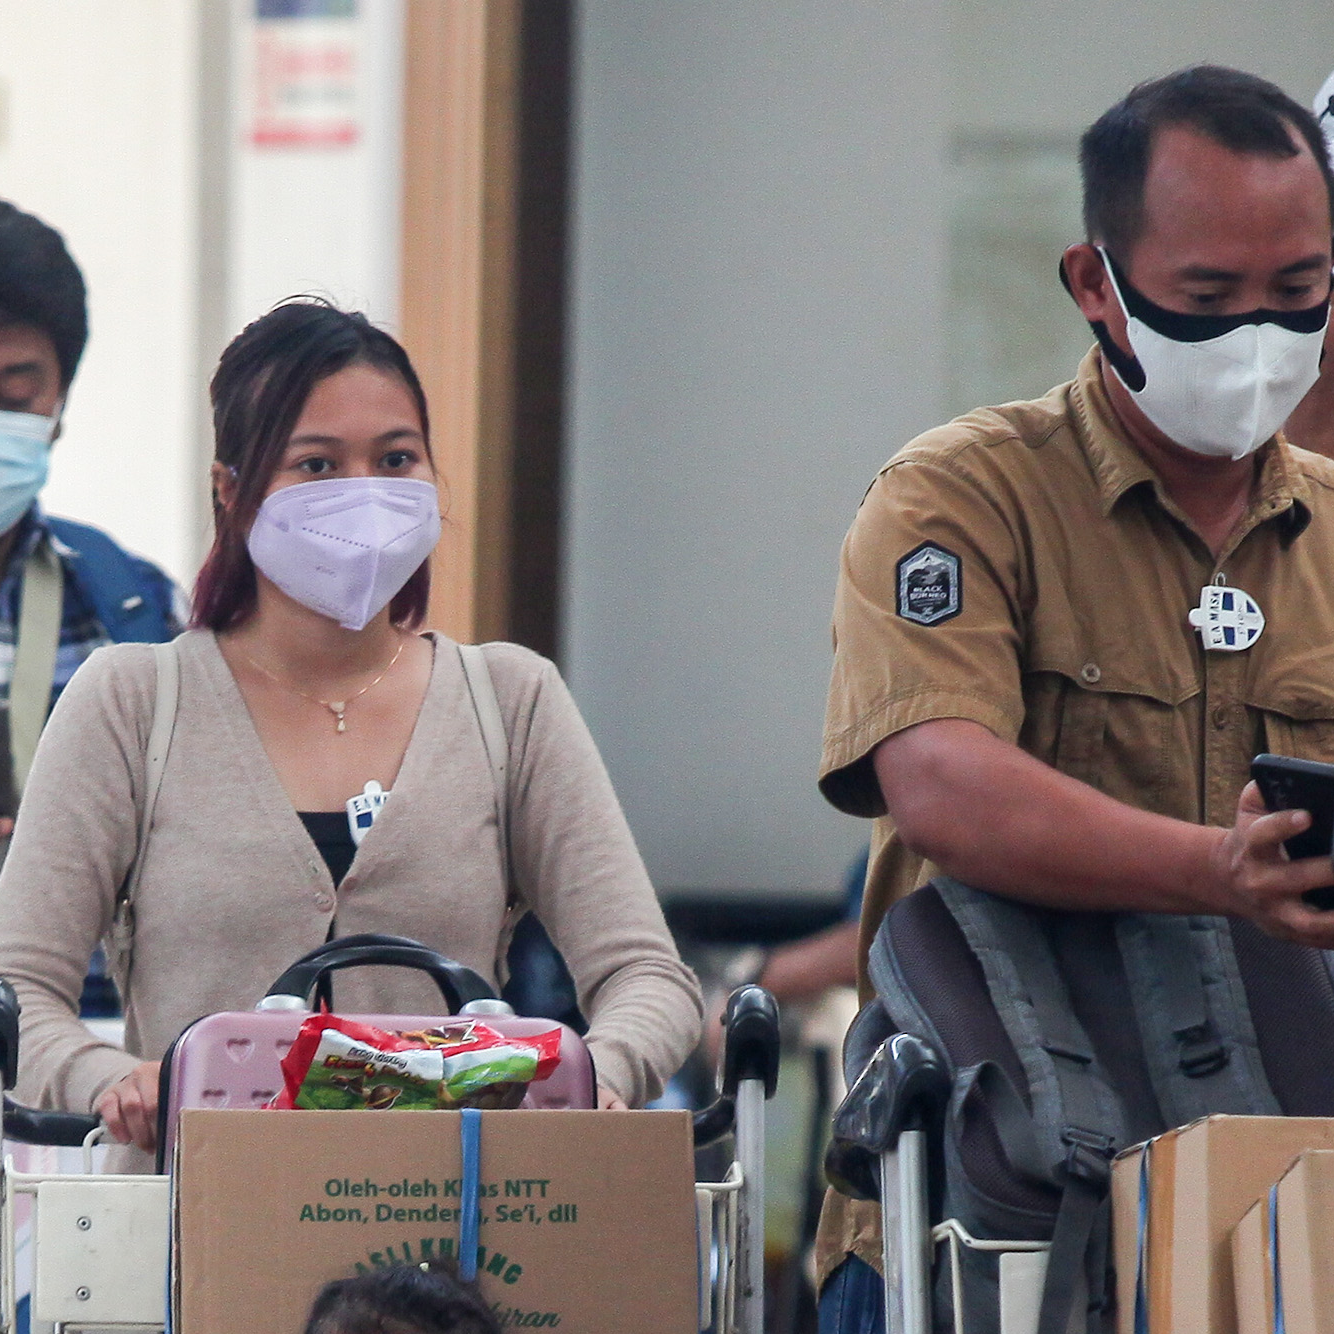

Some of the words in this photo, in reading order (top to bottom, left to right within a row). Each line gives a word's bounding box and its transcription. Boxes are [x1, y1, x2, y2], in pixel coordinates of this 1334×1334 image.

[324, 1178, 437, 1198] Oleh-oleh
[443, 1178, 499, 1198] Kas
[504, 1178, 551, 1197] NTT
[299, 1204, 368, 1224] Abon,
[548, 1203, 578, 1223] dll
